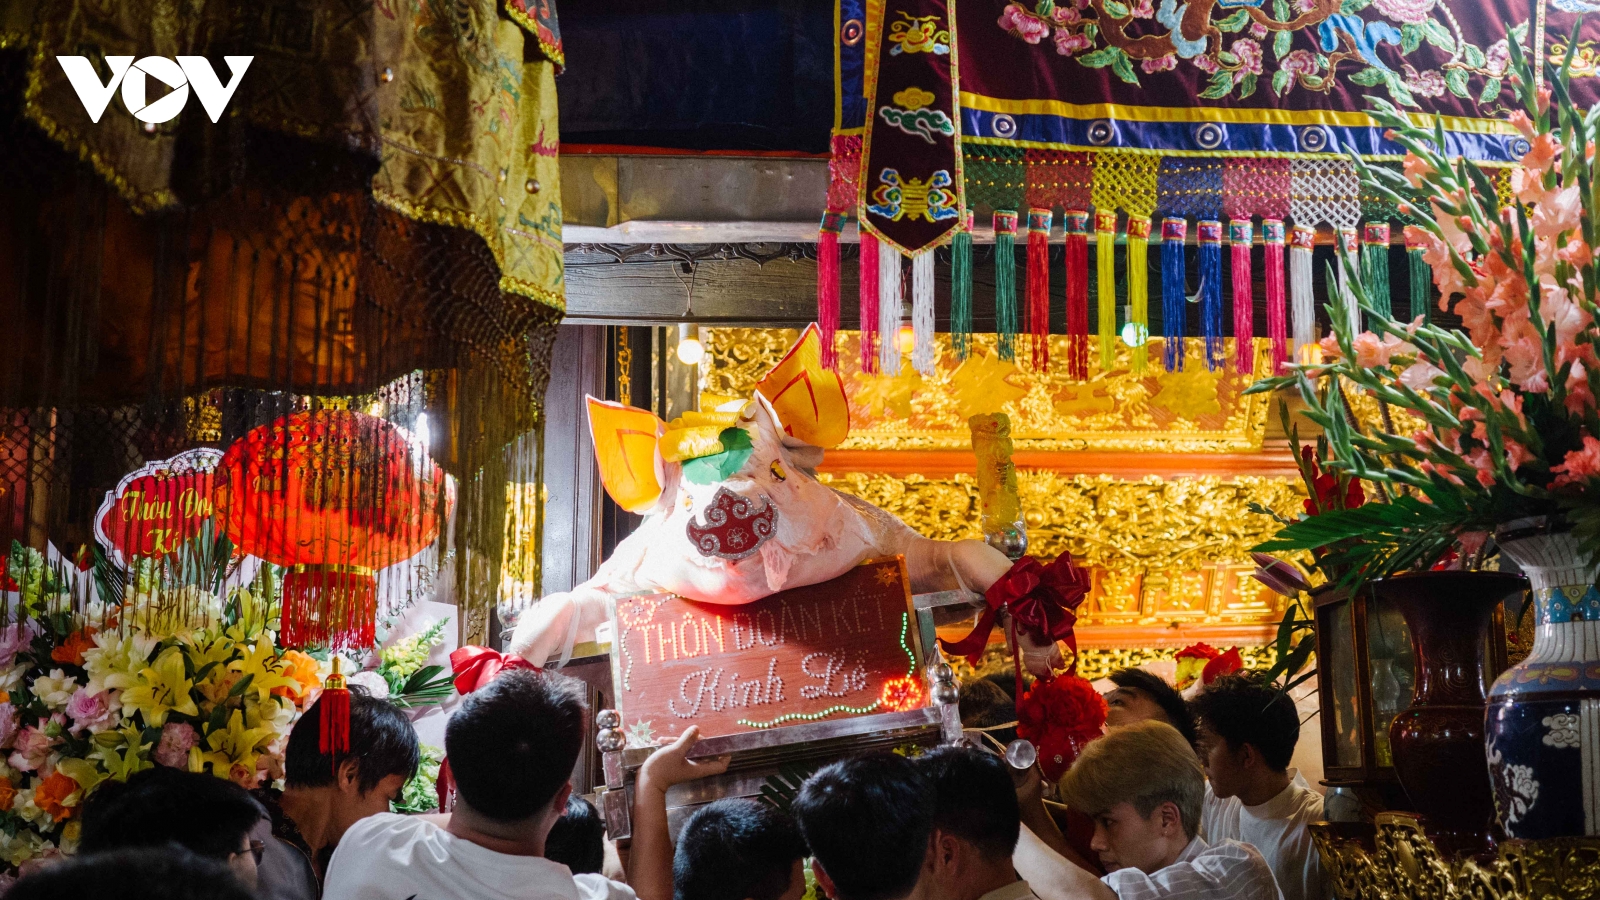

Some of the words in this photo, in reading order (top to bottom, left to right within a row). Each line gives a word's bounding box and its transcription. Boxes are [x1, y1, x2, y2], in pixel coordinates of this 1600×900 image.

[121, 490, 172, 522] Thôn
[636, 612, 725, 664] THÔN
[730, 599, 823, 650] ĐOÀN
[831, 584, 887, 636] KẾT
